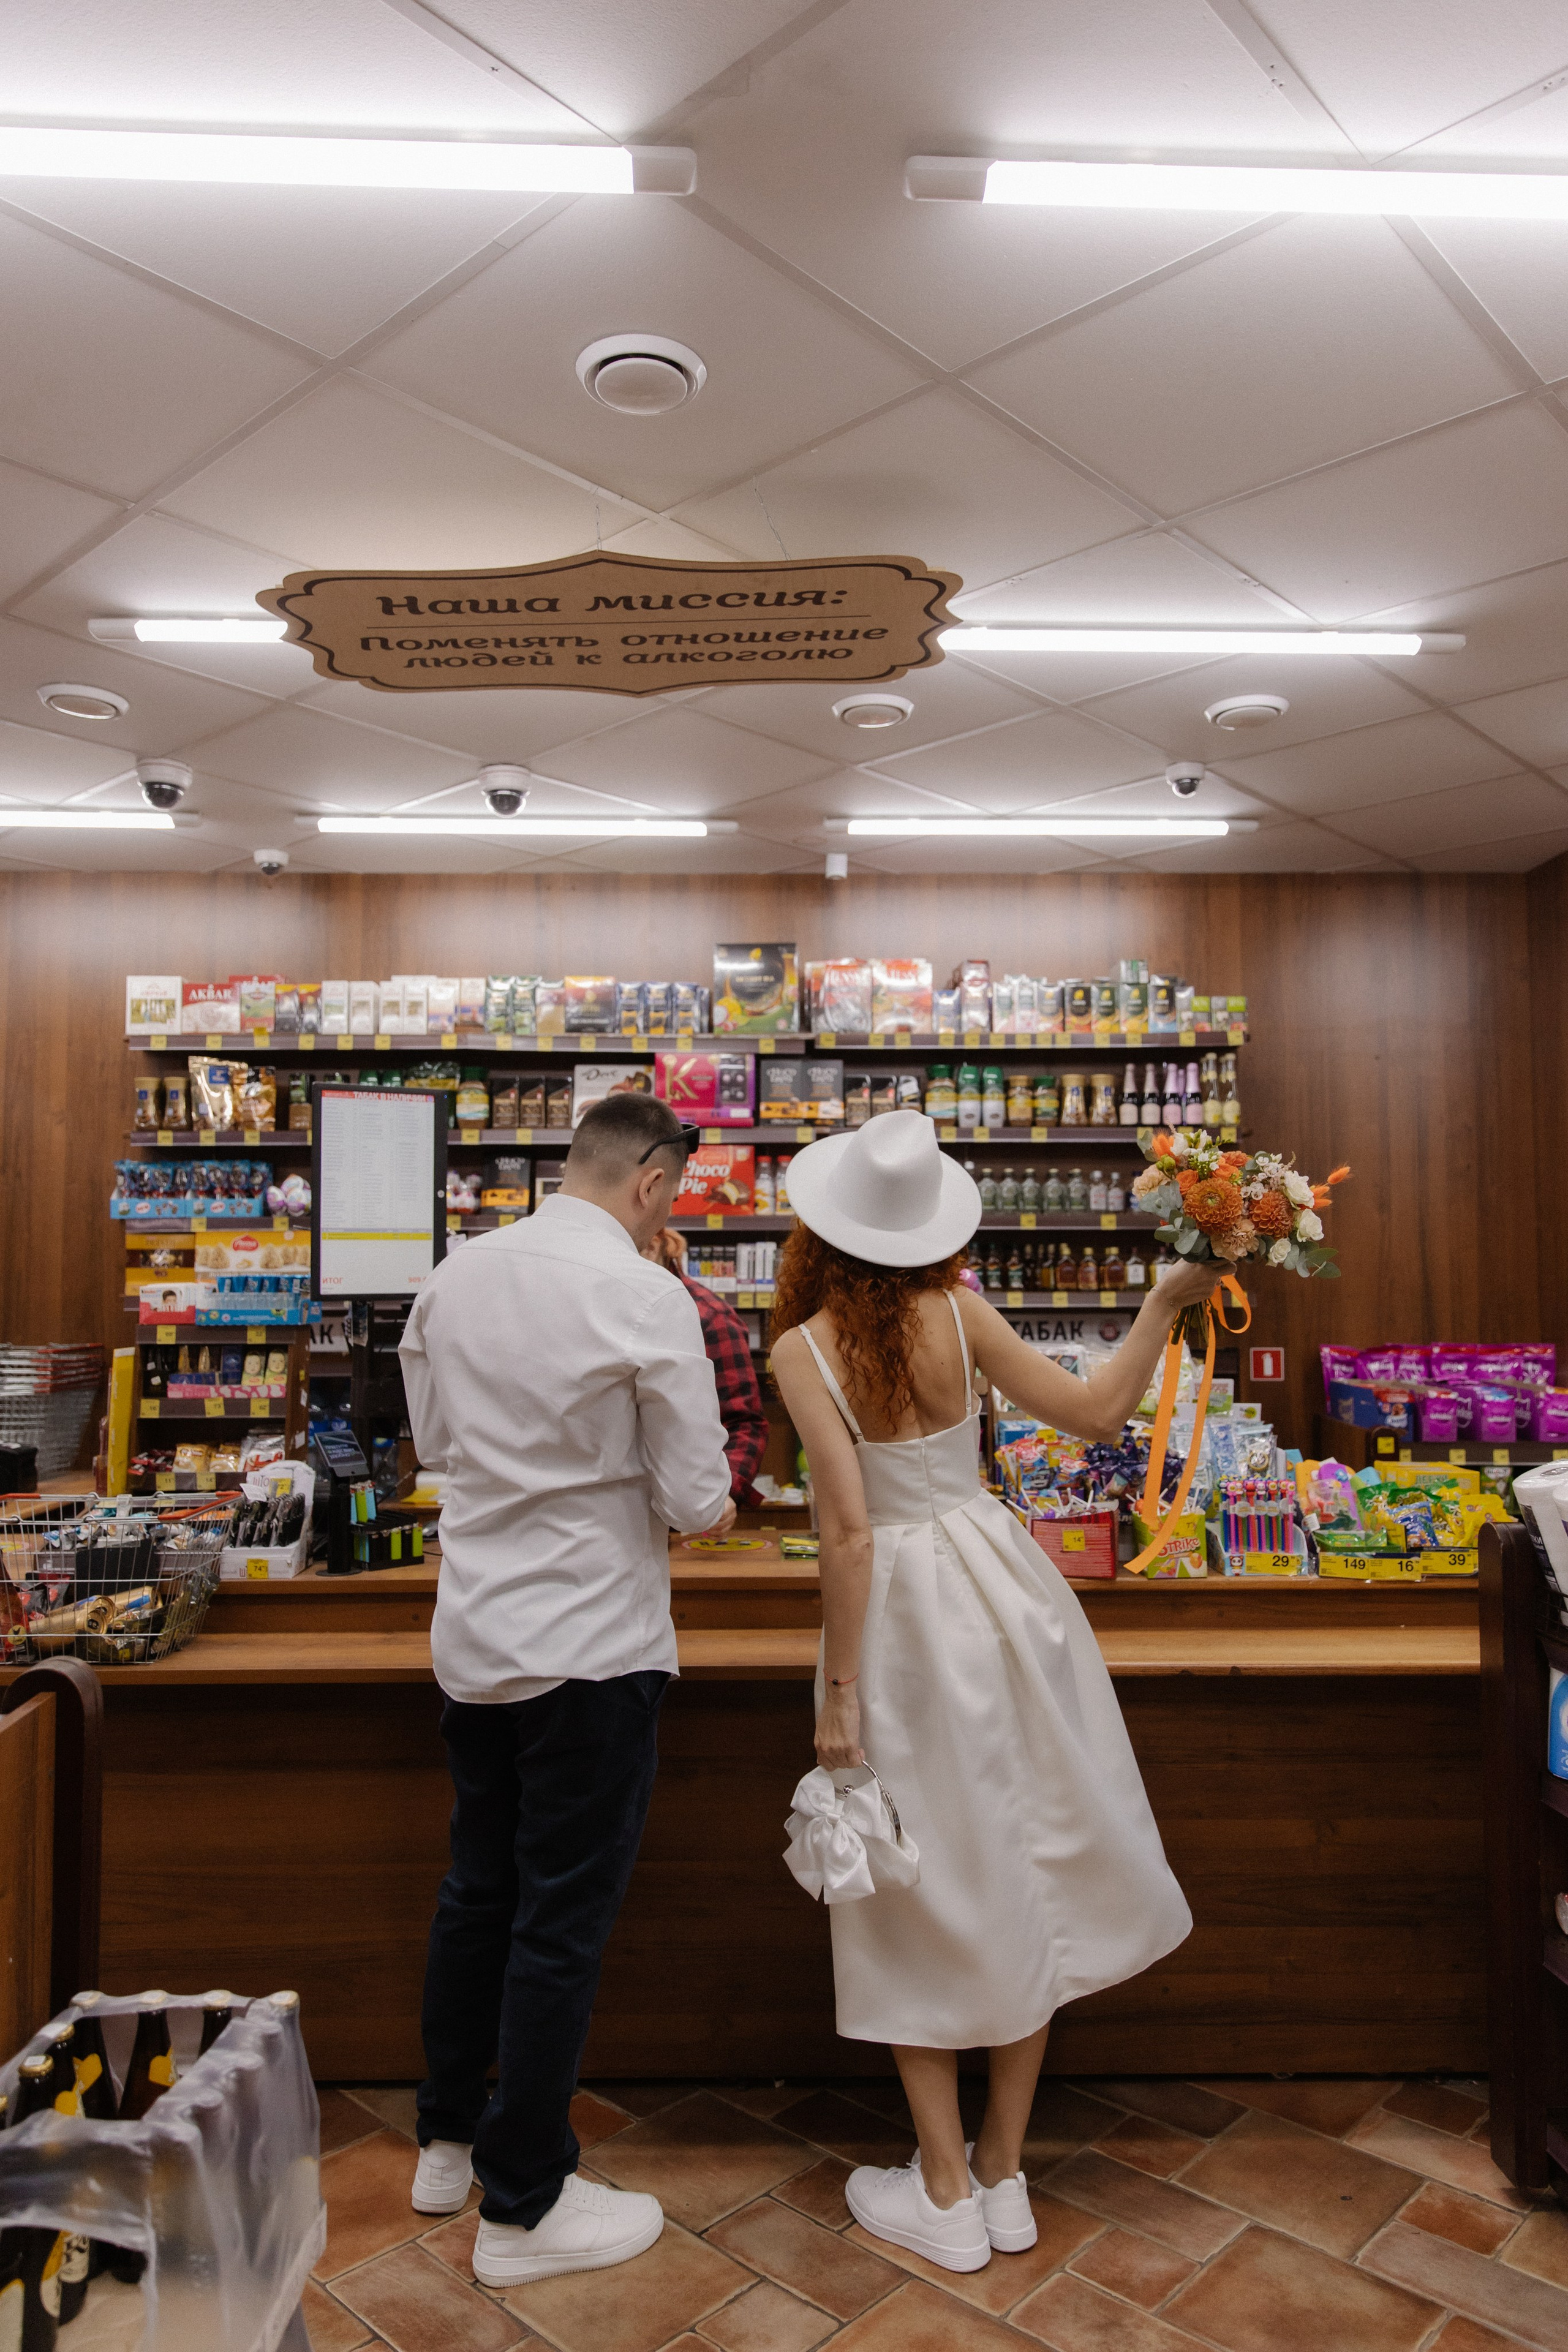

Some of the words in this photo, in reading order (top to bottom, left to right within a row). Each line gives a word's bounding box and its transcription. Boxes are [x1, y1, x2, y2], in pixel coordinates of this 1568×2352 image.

[375, 595, 562, 616] Наша
[586, 589, 848, 611] миссия:
[360, 635, 600, 651] Поменять
[620, 628, 889, 646] отношение
[404, 651, 556, 669] людей
[575, 653, 602, 665] к
[622, 648, 854, 665] алкоголю
[188, 988, 233, 1001] AKBAR
[1272, 1555, 1289, 1567] 29
[1343, 1558, 1366, 1570] 149
[1397, 1560, 1414, 1572] 16
[1449, 1554, 1466, 1566] 39
